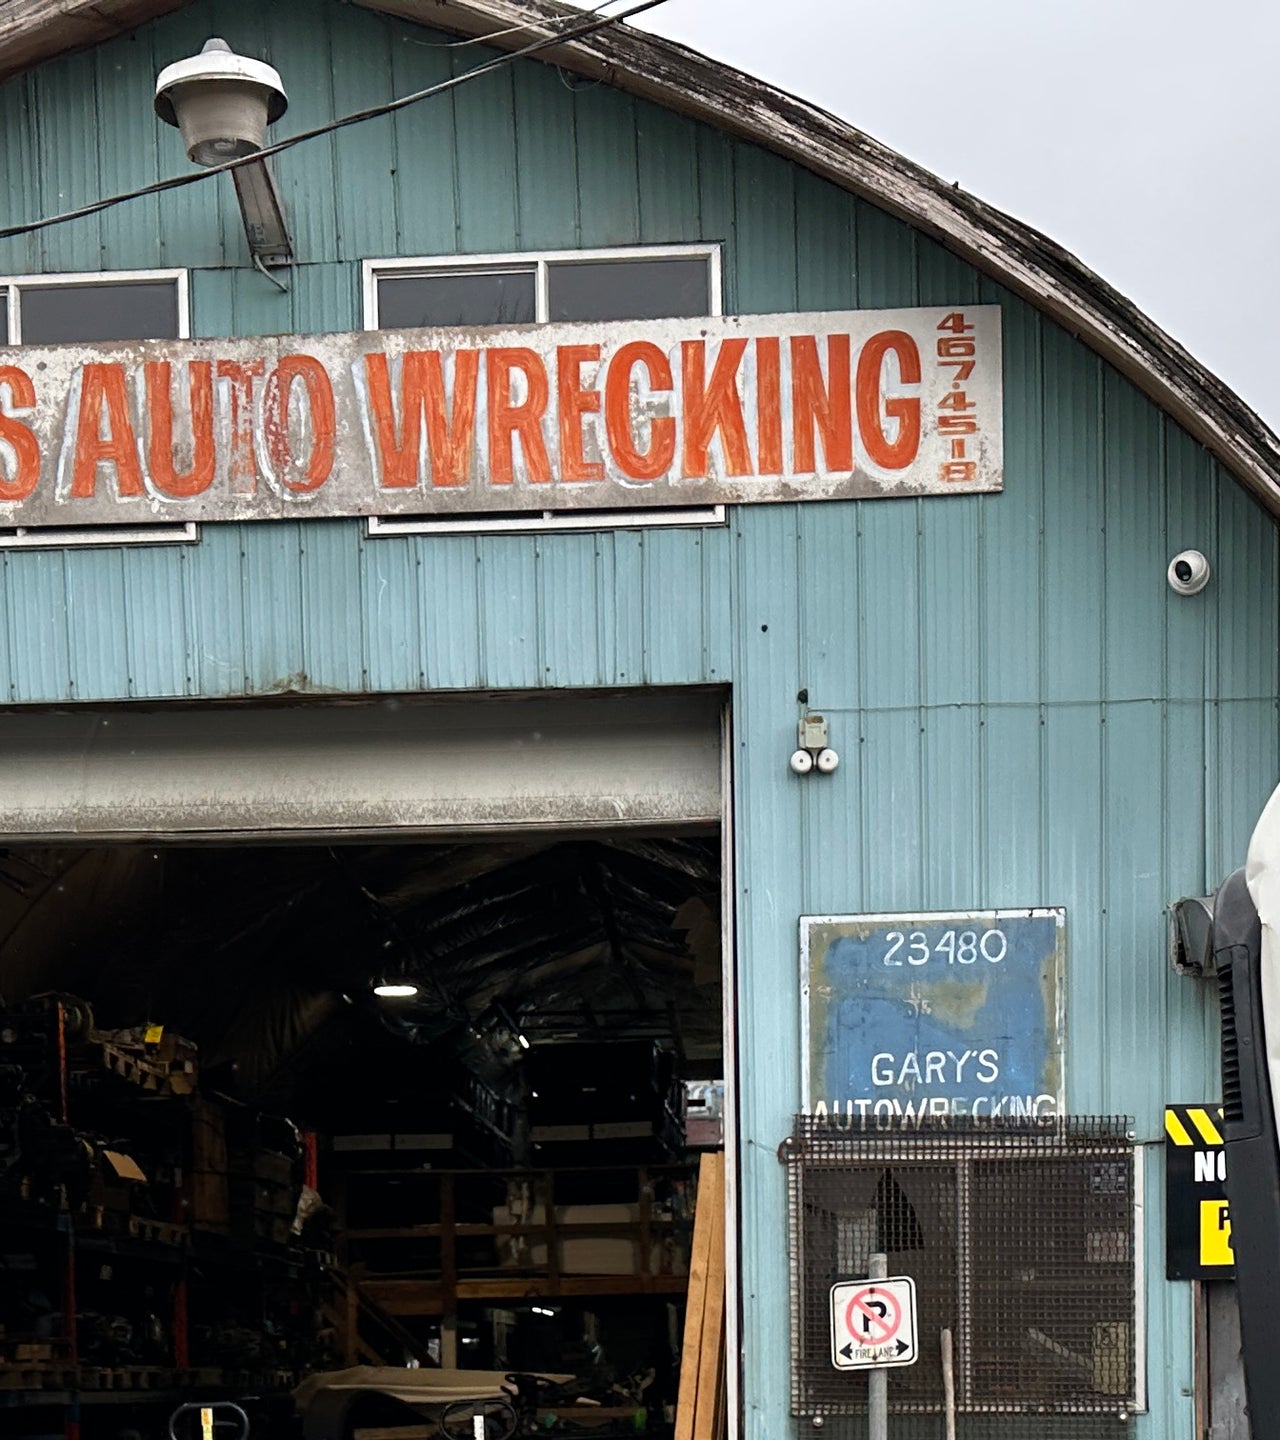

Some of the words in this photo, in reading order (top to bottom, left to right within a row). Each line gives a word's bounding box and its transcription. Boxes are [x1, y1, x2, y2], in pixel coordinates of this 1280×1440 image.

[69, 353, 336, 500] AUTO
[362, 329, 922, 489] WRECKING
[882, 929, 1008, 967] 23480
[870, 1049, 1000, 1087] GARY'S
[814, 1093, 1058, 1131] AUTOWRECKING
[854, 1348, 872, 1359] FIRE
